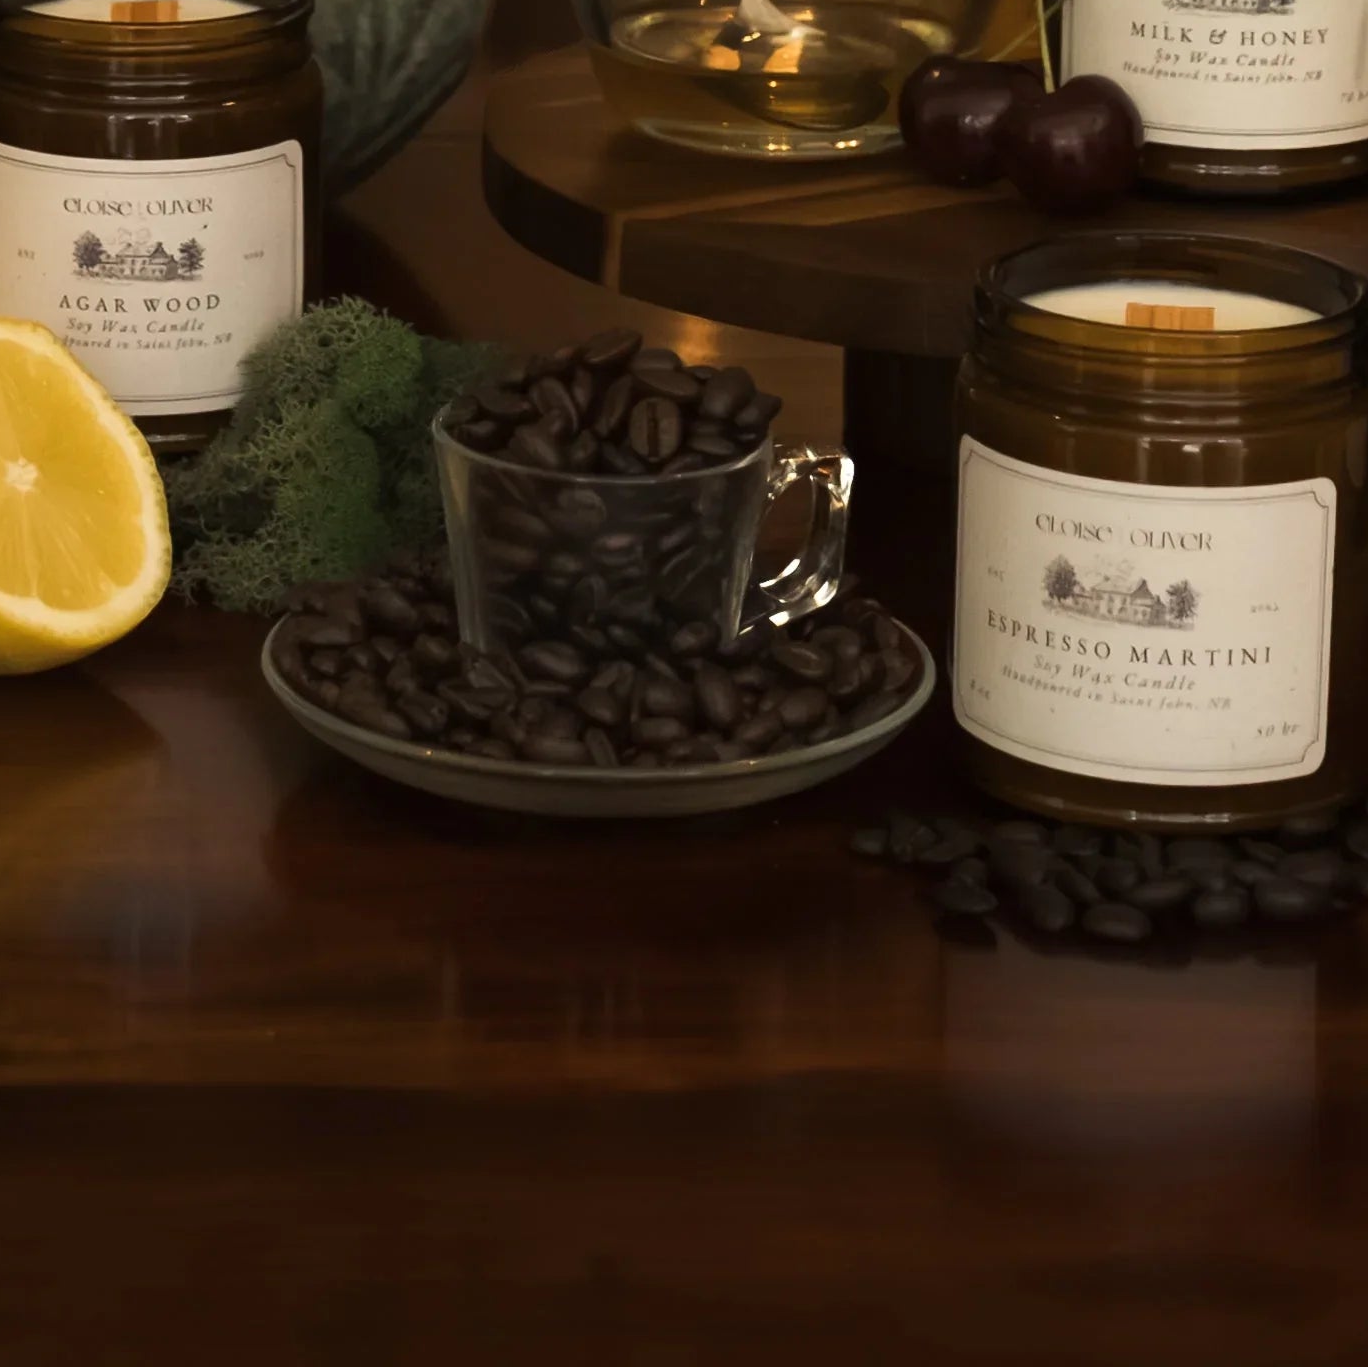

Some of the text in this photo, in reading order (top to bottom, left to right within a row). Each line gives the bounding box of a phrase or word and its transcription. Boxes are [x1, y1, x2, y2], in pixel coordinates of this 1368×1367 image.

[1130, 21, 1329, 46] MILK & HONEY
[1155, 48, 1295, 67] Soy Wax Candle
[146, 196, 214, 216] OLIVER
[59, 293, 221, 313] AGAR WOOD
[66, 317, 205, 334] Soy Wax Candle
[1130, 528, 1213, 552] OLIVER
[986, 608, 1273, 668] ESPRESSO MARTINI
[1033, 654, 1196, 691] Soy Wax Candle
